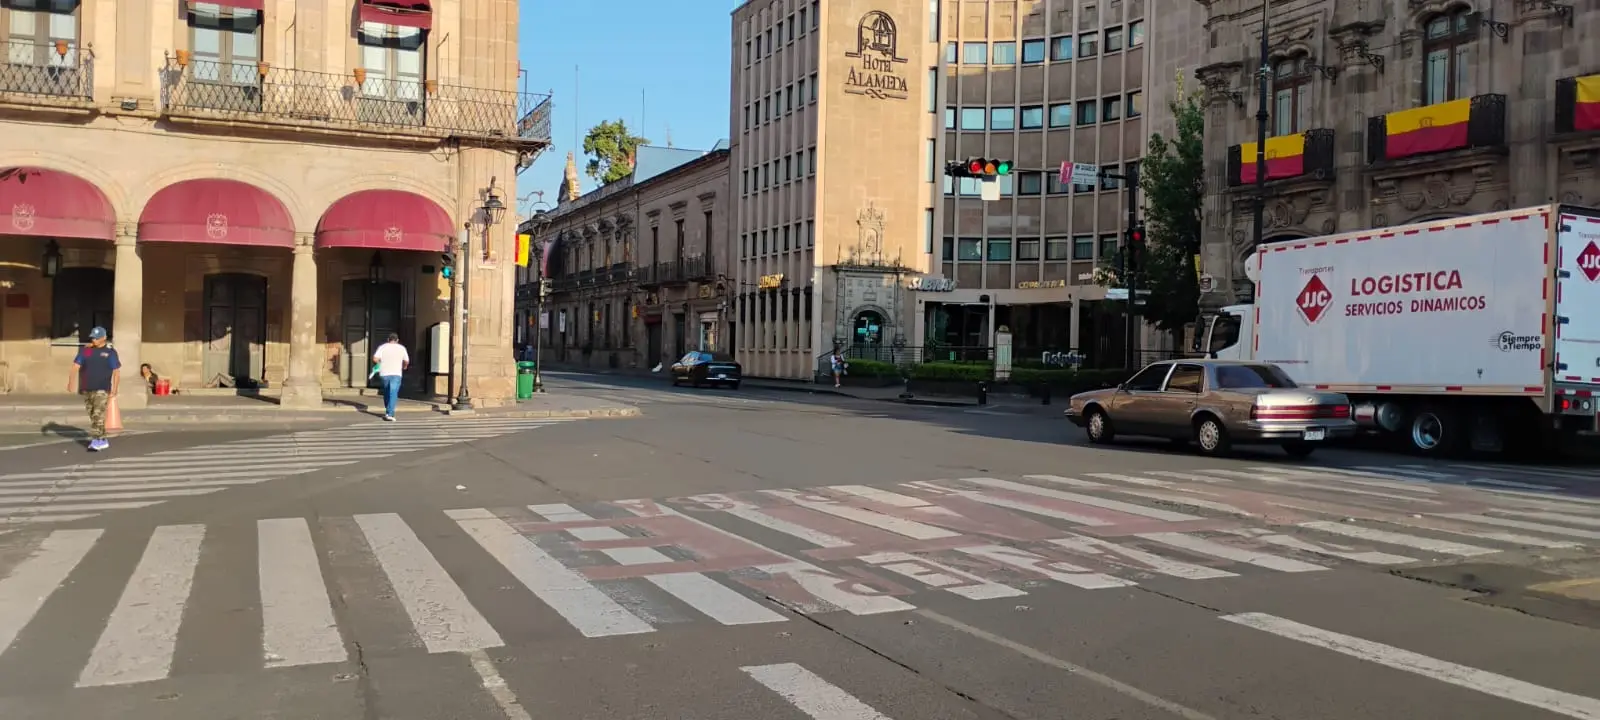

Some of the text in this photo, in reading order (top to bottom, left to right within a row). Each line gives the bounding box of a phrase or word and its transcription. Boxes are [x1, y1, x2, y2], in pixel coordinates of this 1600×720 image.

[863, 54, 893, 73] HOTEL
[844, 65, 908, 92] ALAMEDA
[1350, 269, 1463, 297] LOGISTICA
[1302, 290, 1328, 309] JJC
[1344, 300, 1403, 317] SERVICIOS
[1410, 295, 1486, 313] DINAMICOS
[1502, 334, 1541, 345] Siempre
